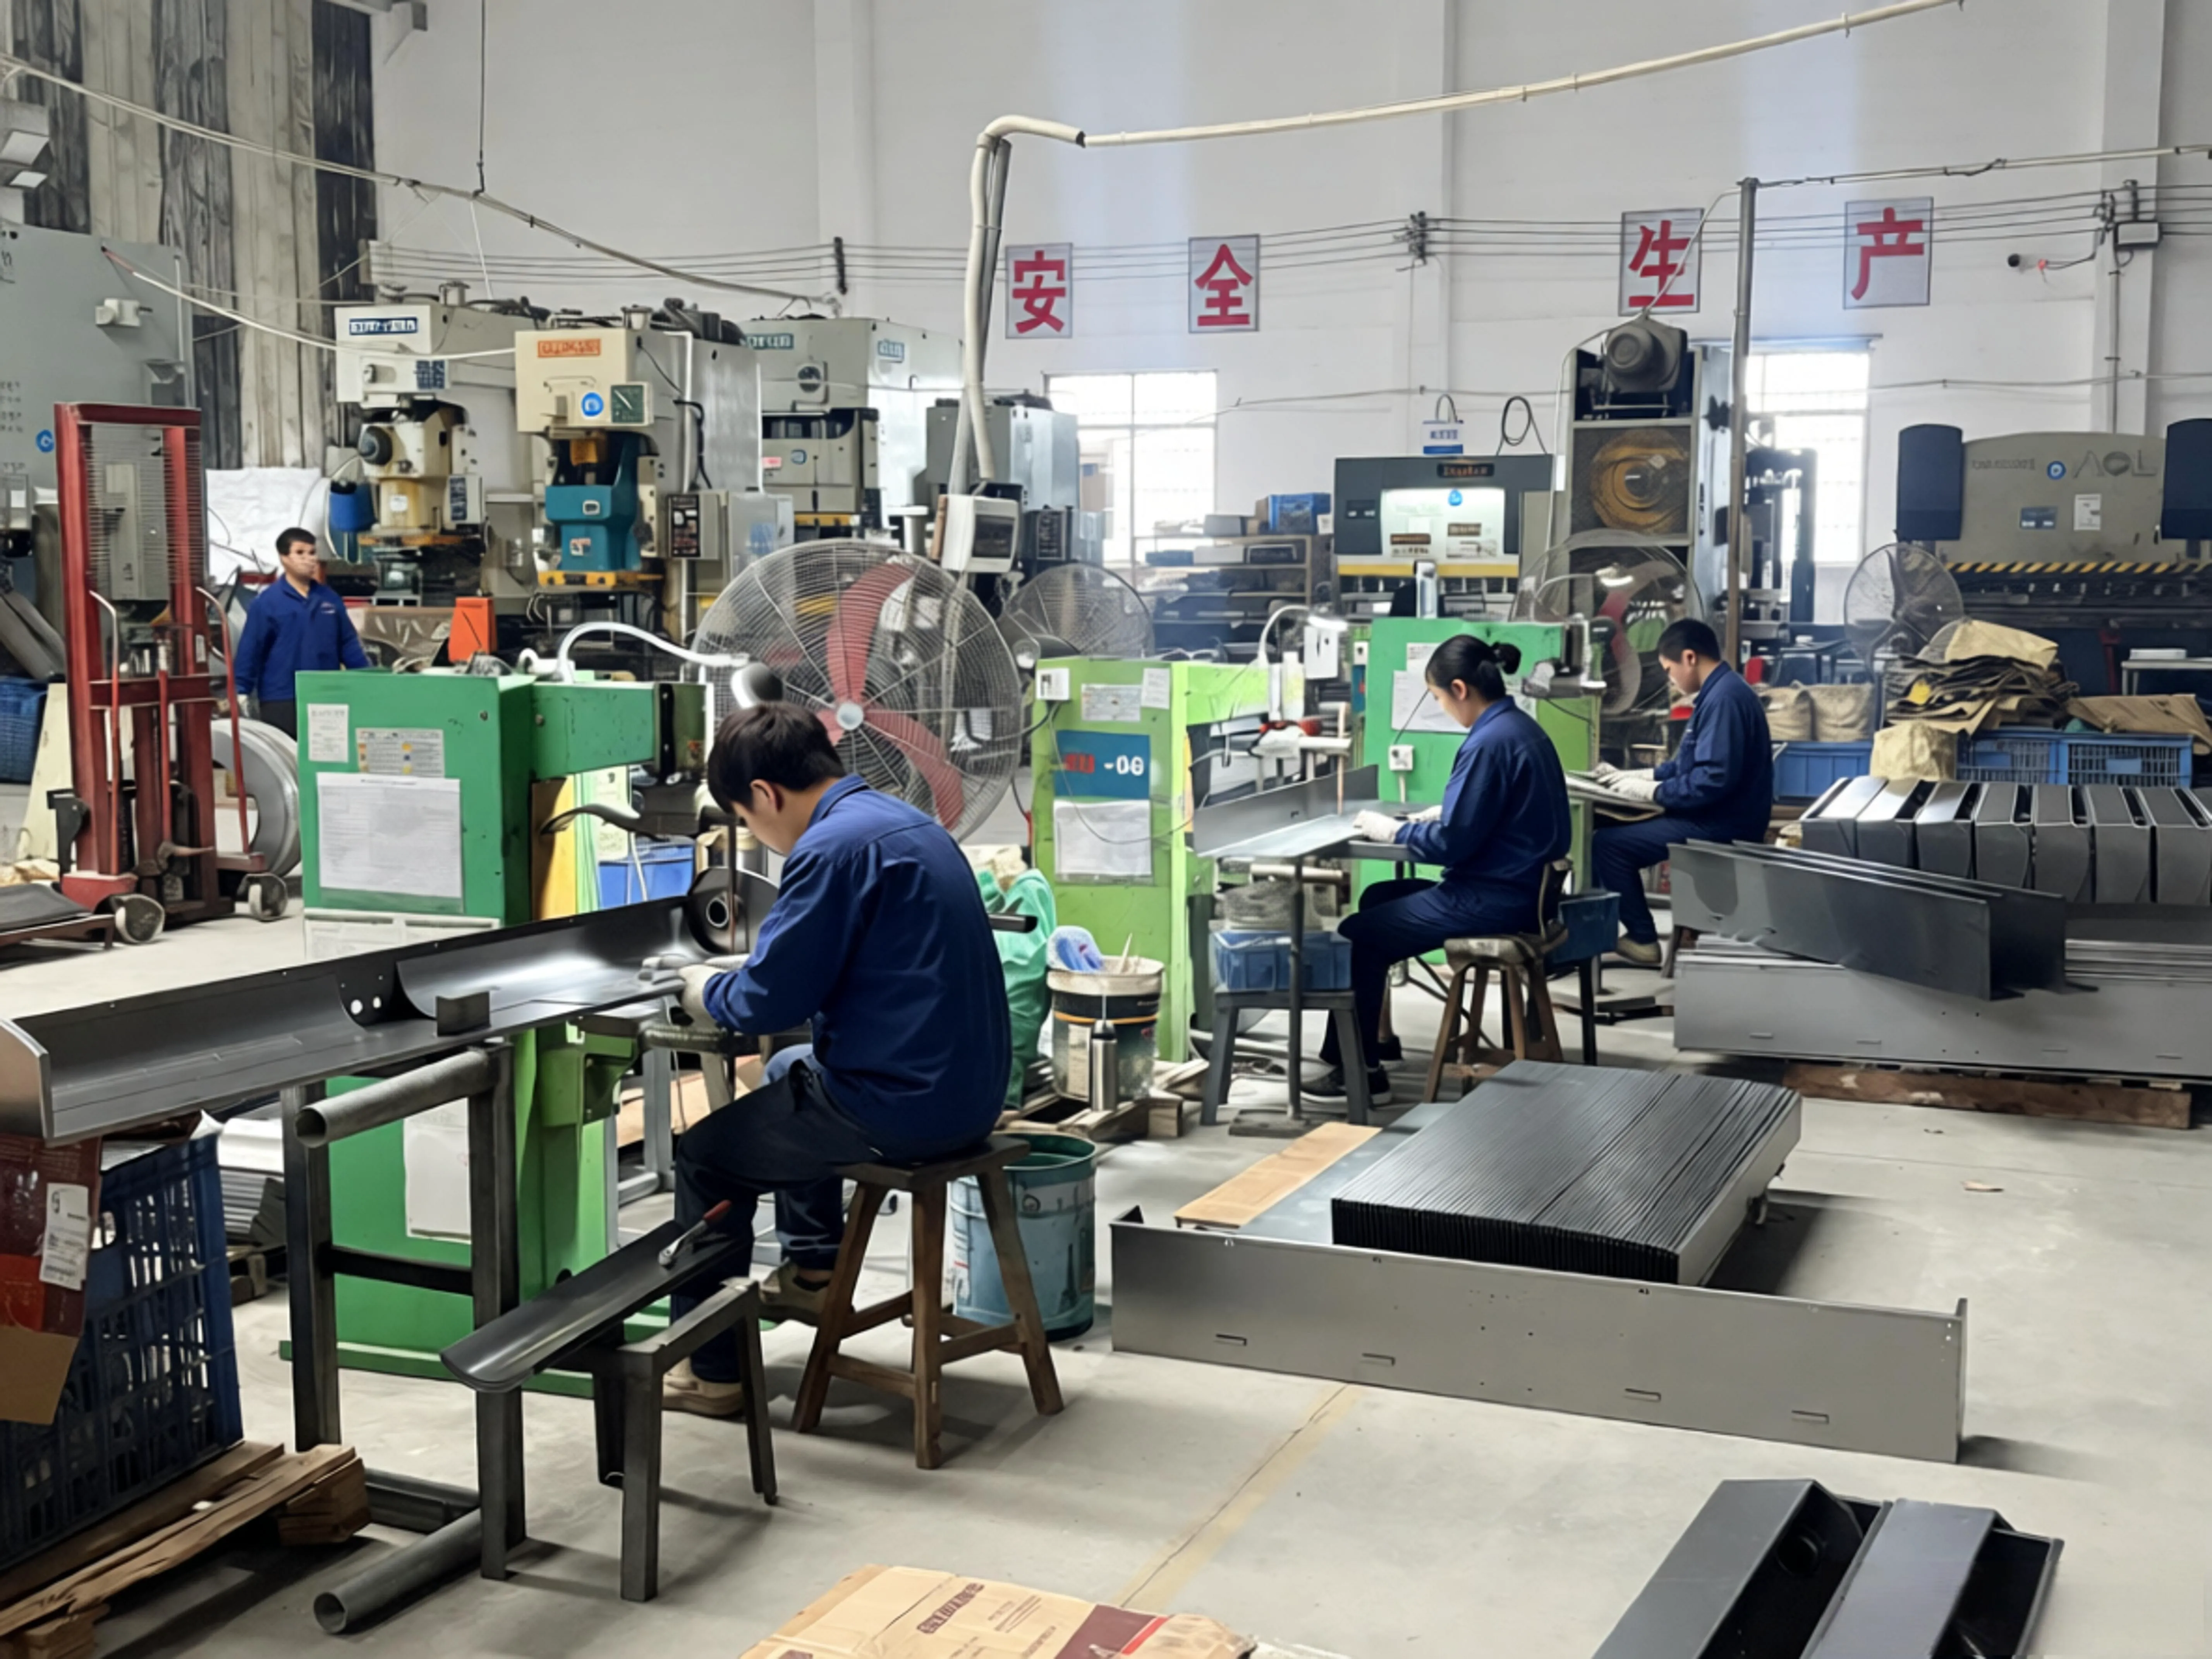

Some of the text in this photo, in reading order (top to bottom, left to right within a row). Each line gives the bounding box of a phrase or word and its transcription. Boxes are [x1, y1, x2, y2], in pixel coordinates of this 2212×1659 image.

[1012, 250, 1066, 334] 安
[1194, 244, 1253, 326] 全
[1628, 220, 1694, 307] 生
[1851, 207, 1924, 300] 产
